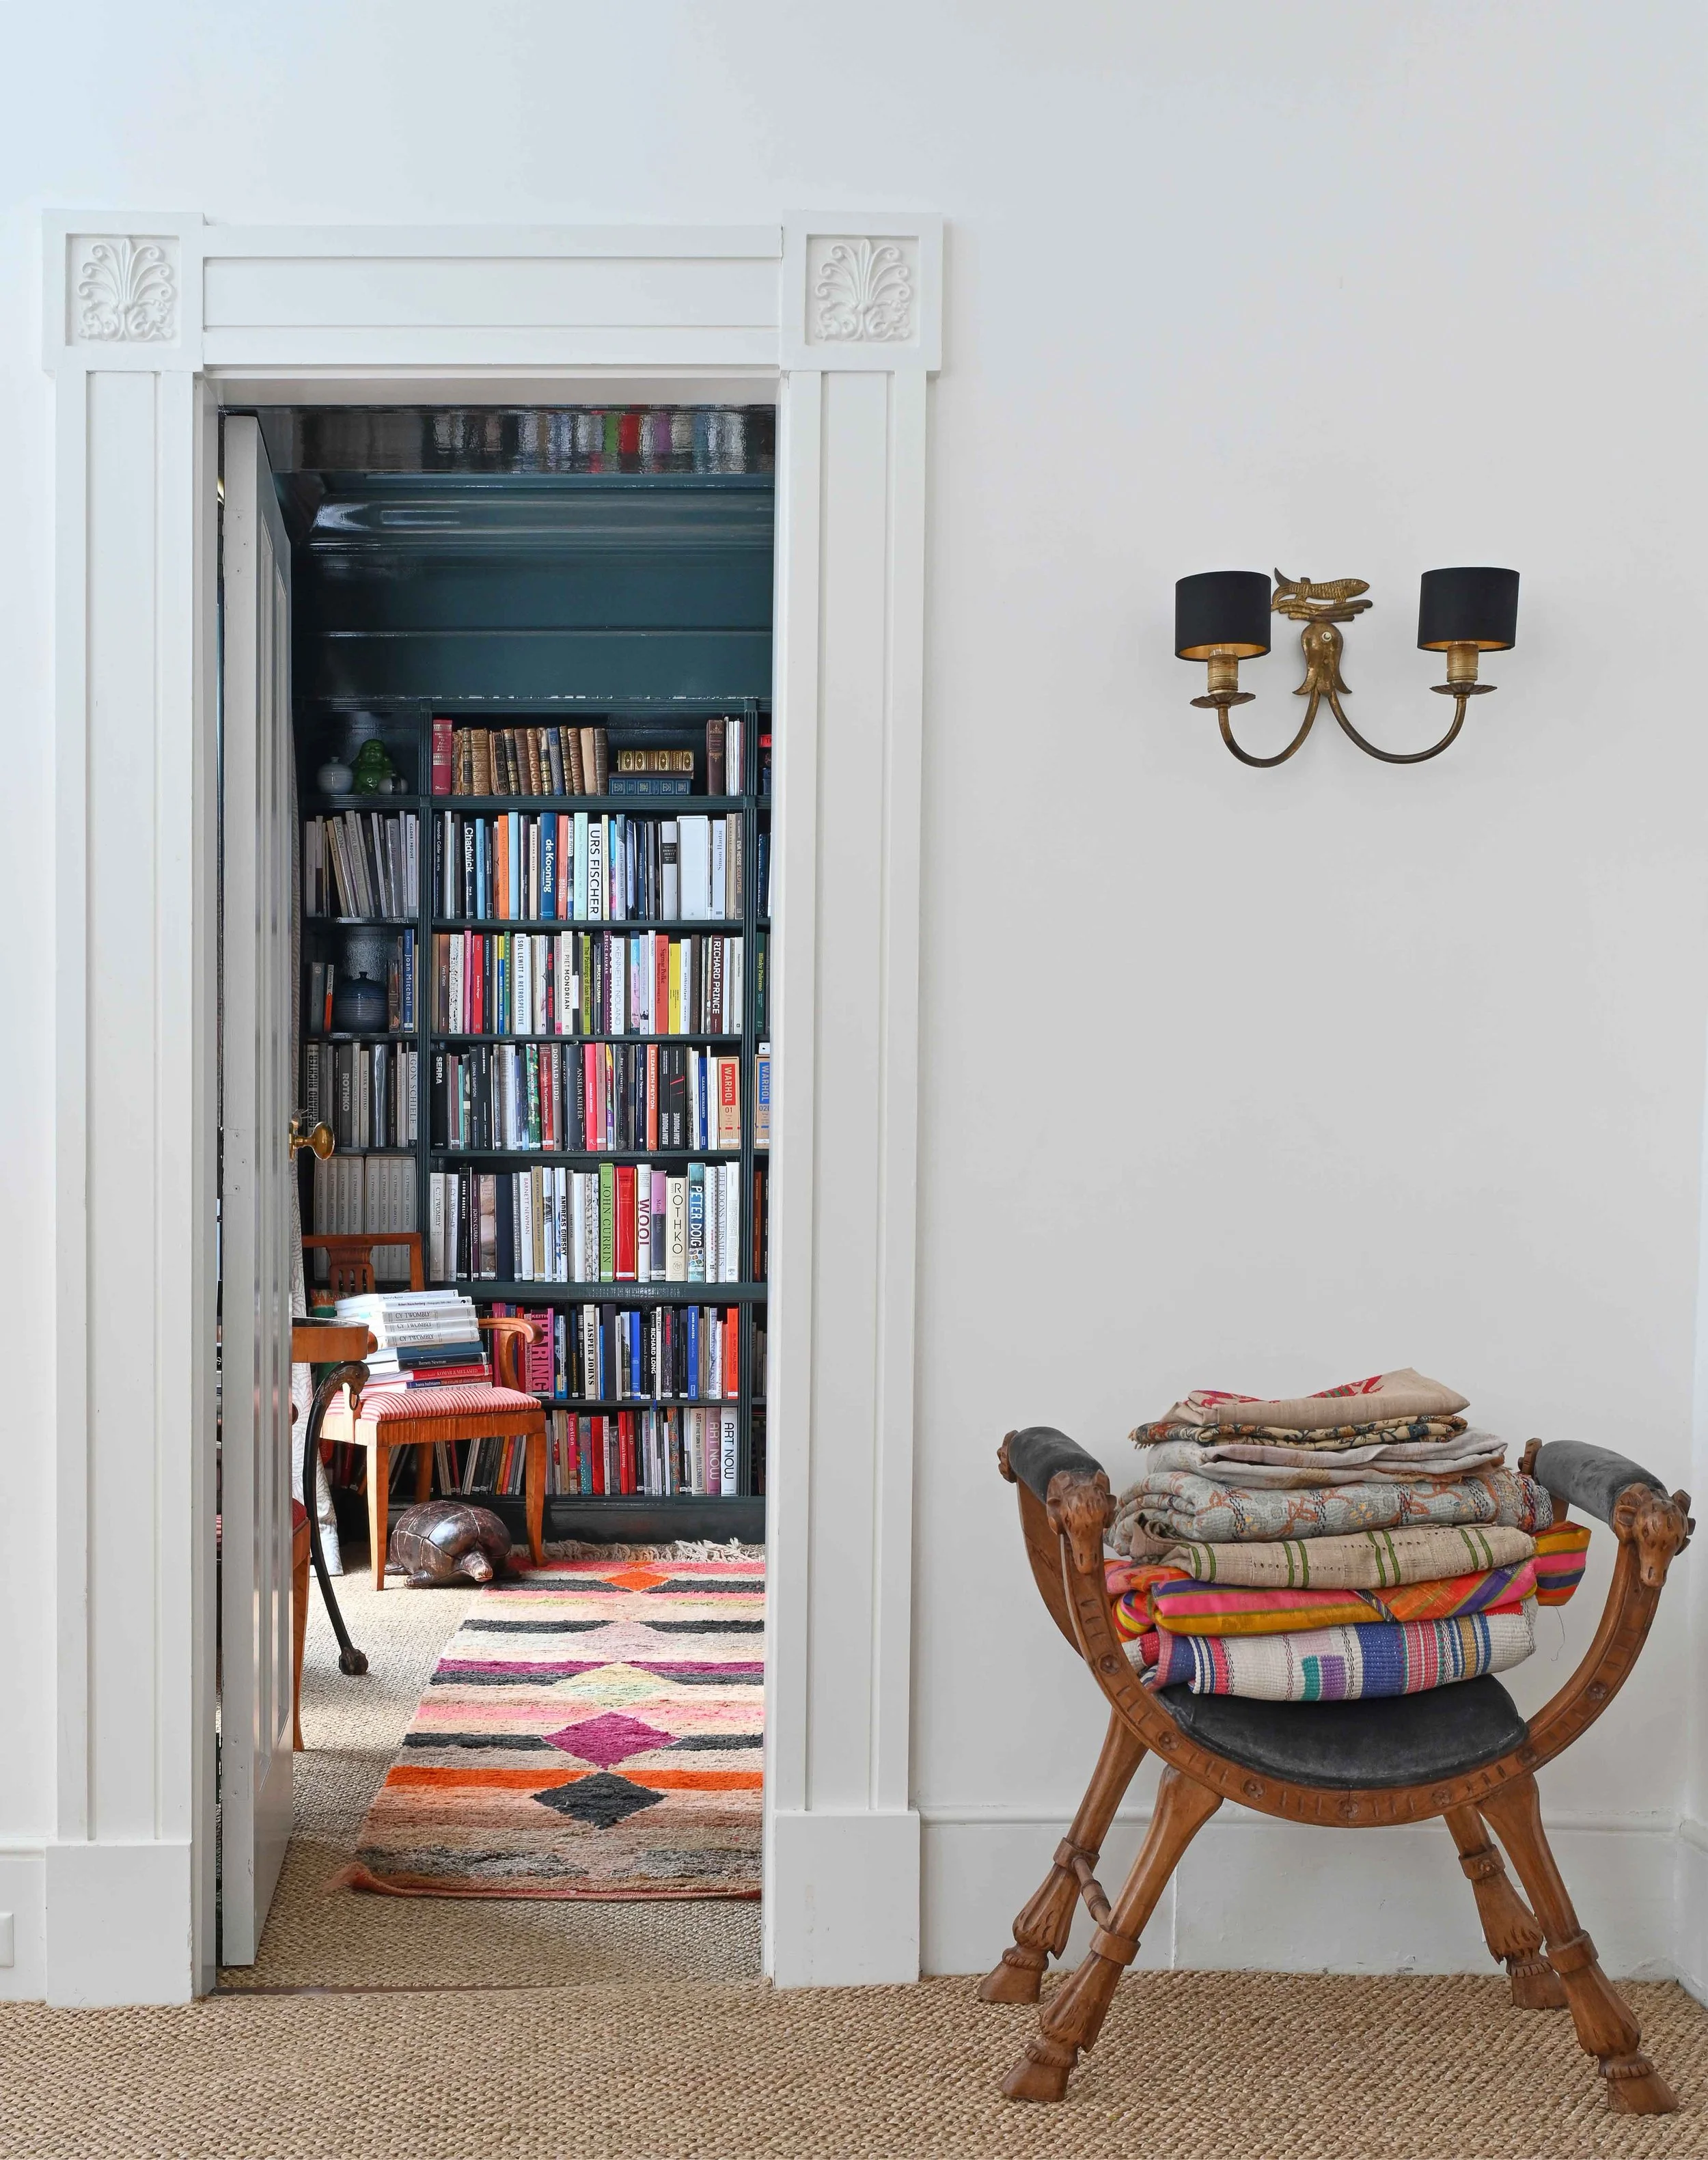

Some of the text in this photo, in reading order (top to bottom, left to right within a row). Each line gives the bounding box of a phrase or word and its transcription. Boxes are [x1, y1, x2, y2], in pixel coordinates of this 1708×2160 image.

[335, 821, 344, 848] BACON
[465, 827, 473, 872] Chadwick
[544, 839, 553, 893] de Kooning
[590, 831, 600, 914] URS FISCHER
[713, 941, 721, 979] RICHARD
[308, 1055, 318, 1128] GERHARD RICHTER
[435, 1187, 441, 1196] CY
[672, 1182, 683, 1254] ROTHKO
[691, 1186, 702, 1247] PETER DOIG
[603, 1184, 611, 1264] JOHN CURRIN
[638, 1198, 649, 1250] WOOL
[710, 1422, 719, 1480] ART NOW
[725, 1422, 734, 1479] ART NOW
